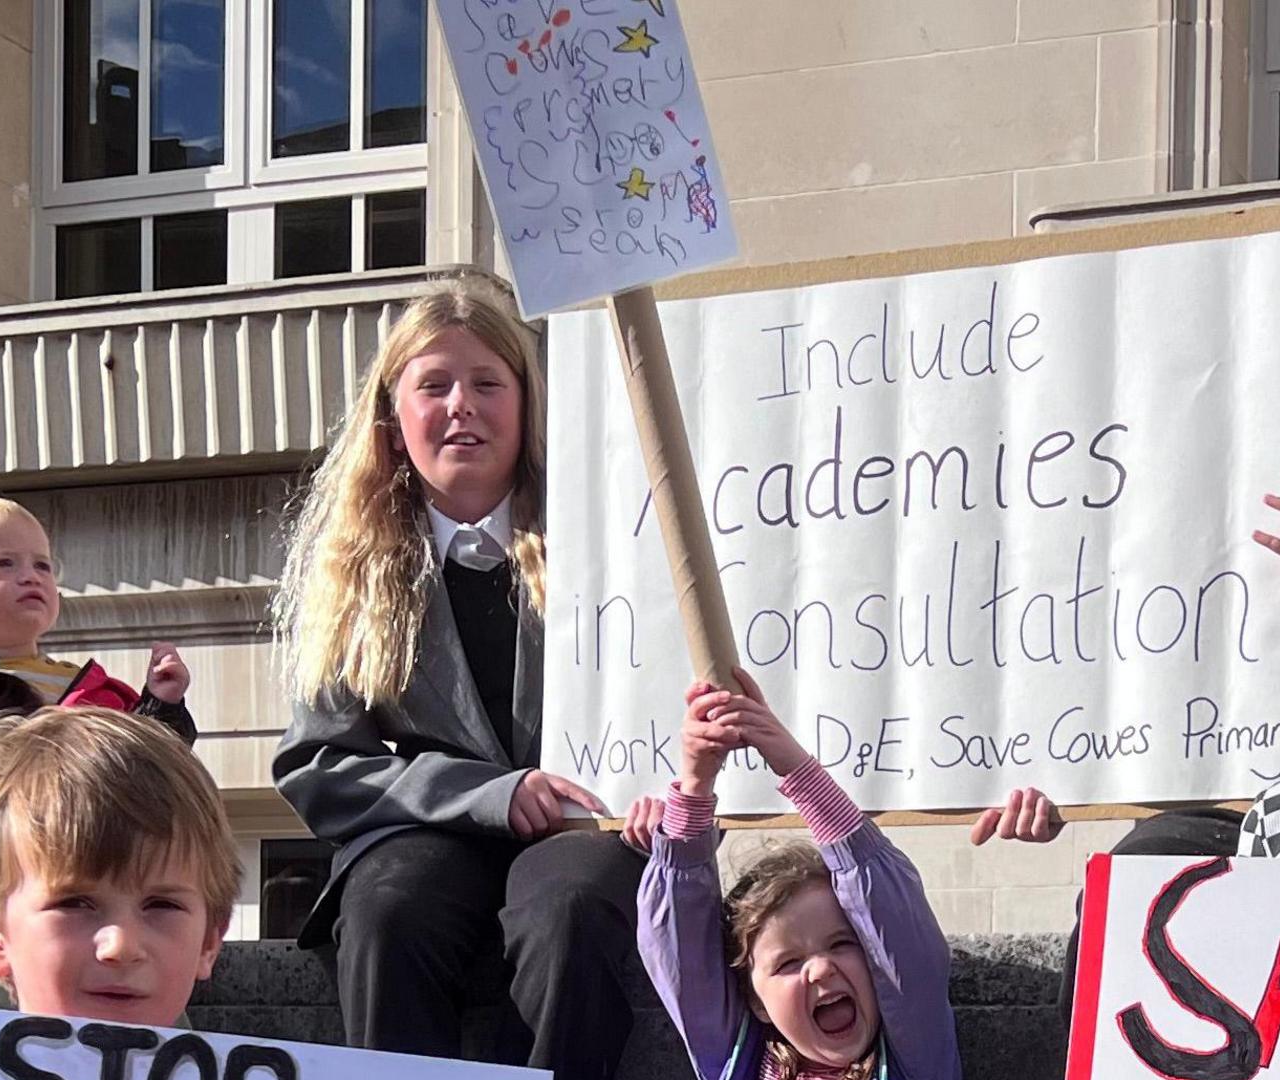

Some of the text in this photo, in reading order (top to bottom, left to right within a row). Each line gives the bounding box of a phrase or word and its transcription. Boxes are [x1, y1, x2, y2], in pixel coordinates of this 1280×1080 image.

[755, 281, 1046, 401] Include
[634, 404, 1130, 537] cademies
[573, 592, 643, 671] in
[564, 718, 677, 779] Work
[930, 713, 1032, 769] Save
[1047, 706, 1153, 763] Cowes
